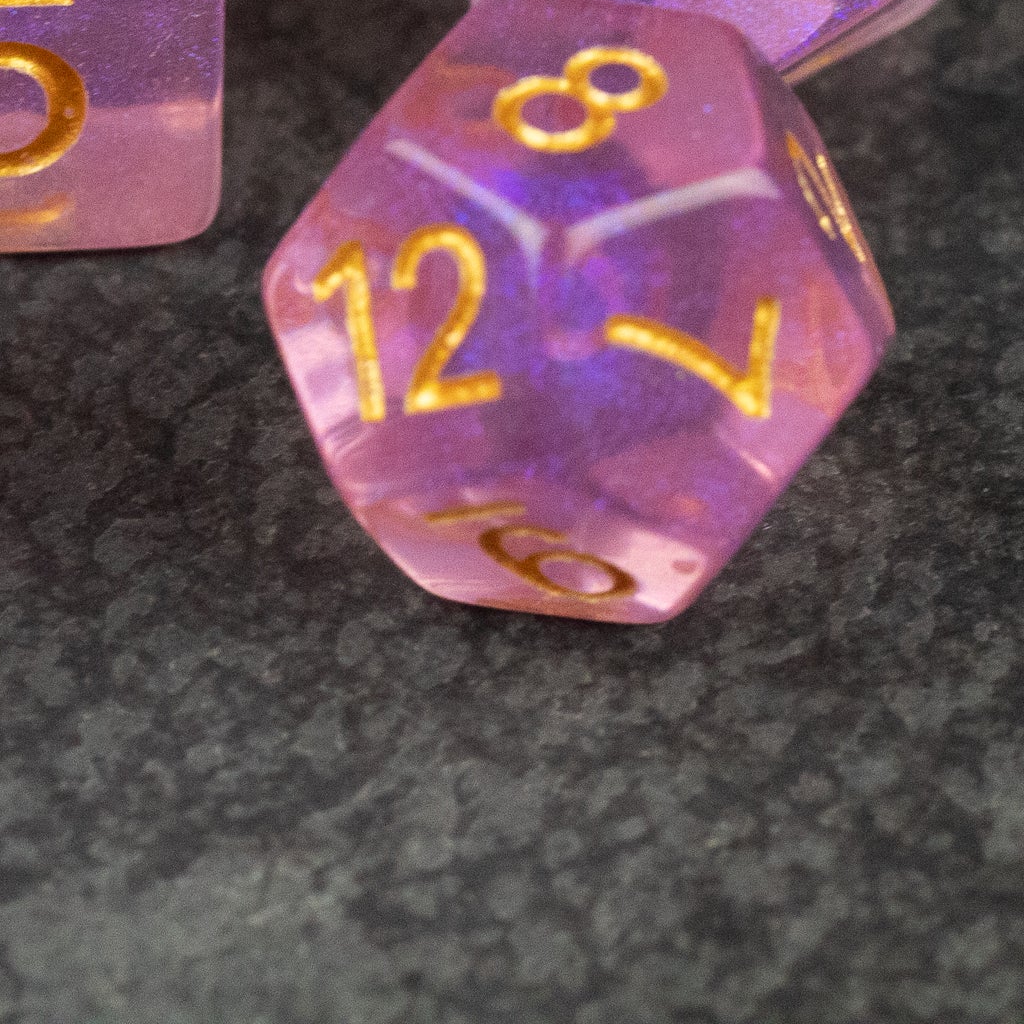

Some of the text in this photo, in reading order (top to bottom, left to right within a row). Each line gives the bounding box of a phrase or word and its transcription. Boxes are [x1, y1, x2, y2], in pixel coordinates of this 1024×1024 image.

[493, 47, 669, 151] 8
[313, 224, 503, 423] 12
[605, 295, 782, 419] 7
